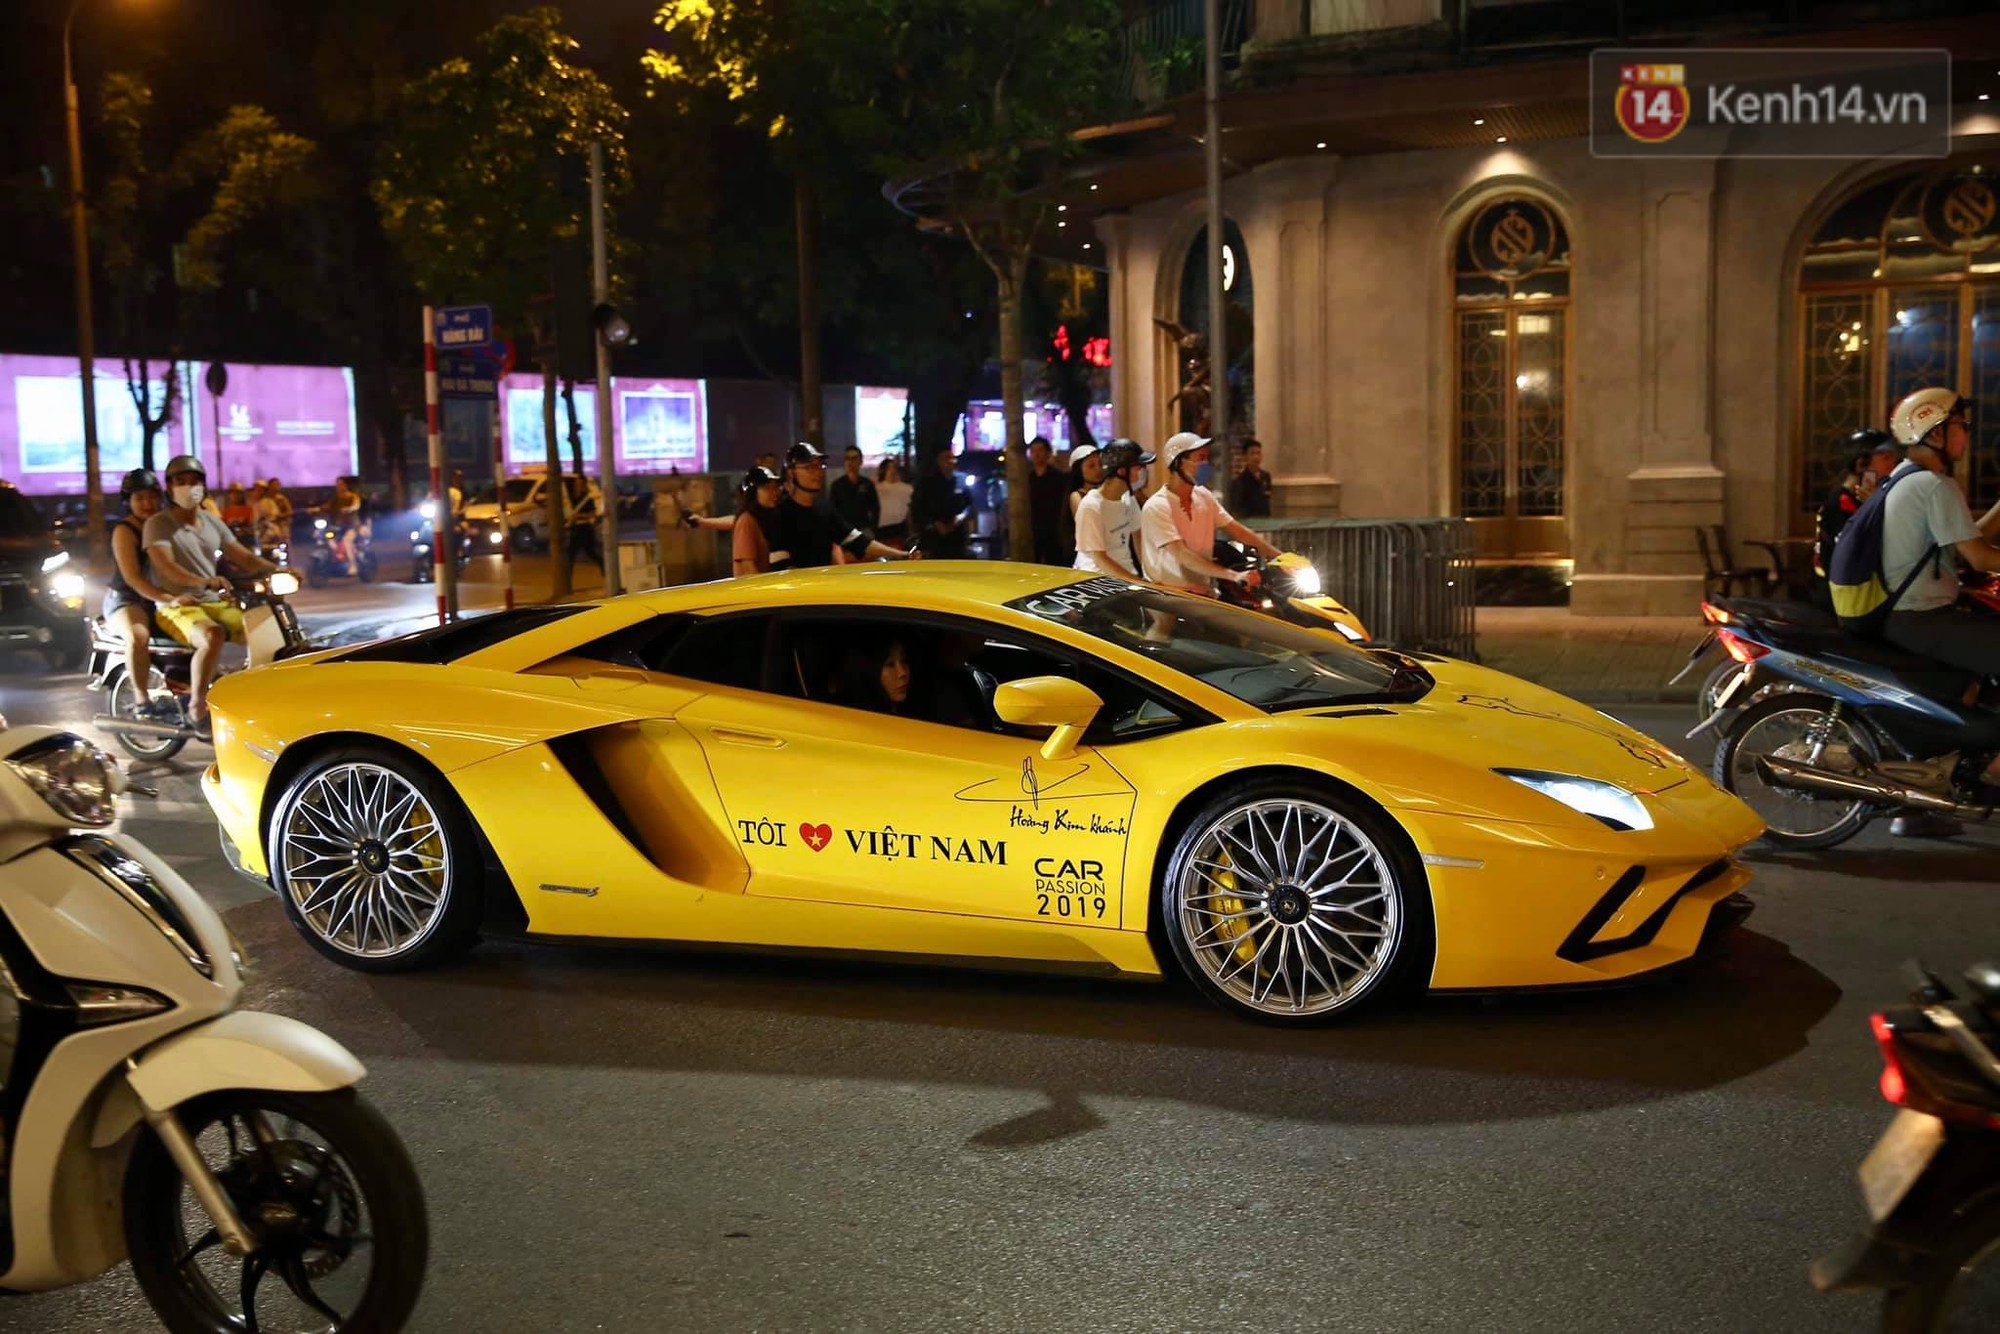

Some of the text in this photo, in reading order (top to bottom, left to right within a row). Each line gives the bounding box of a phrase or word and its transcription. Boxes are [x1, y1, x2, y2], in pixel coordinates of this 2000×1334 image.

[1026, 587, 1101, 616] CAR
[1010, 804, 1049, 835] Hoàng
[1054, 809, 1087, 831] Kim
[737, 817, 1008, 867] TÔI VIỆT NAM
[1034, 857, 1104, 881] CAR
[1035, 879, 1106, 896] PASSION
[1036, 894, 1106, 919] 2019
